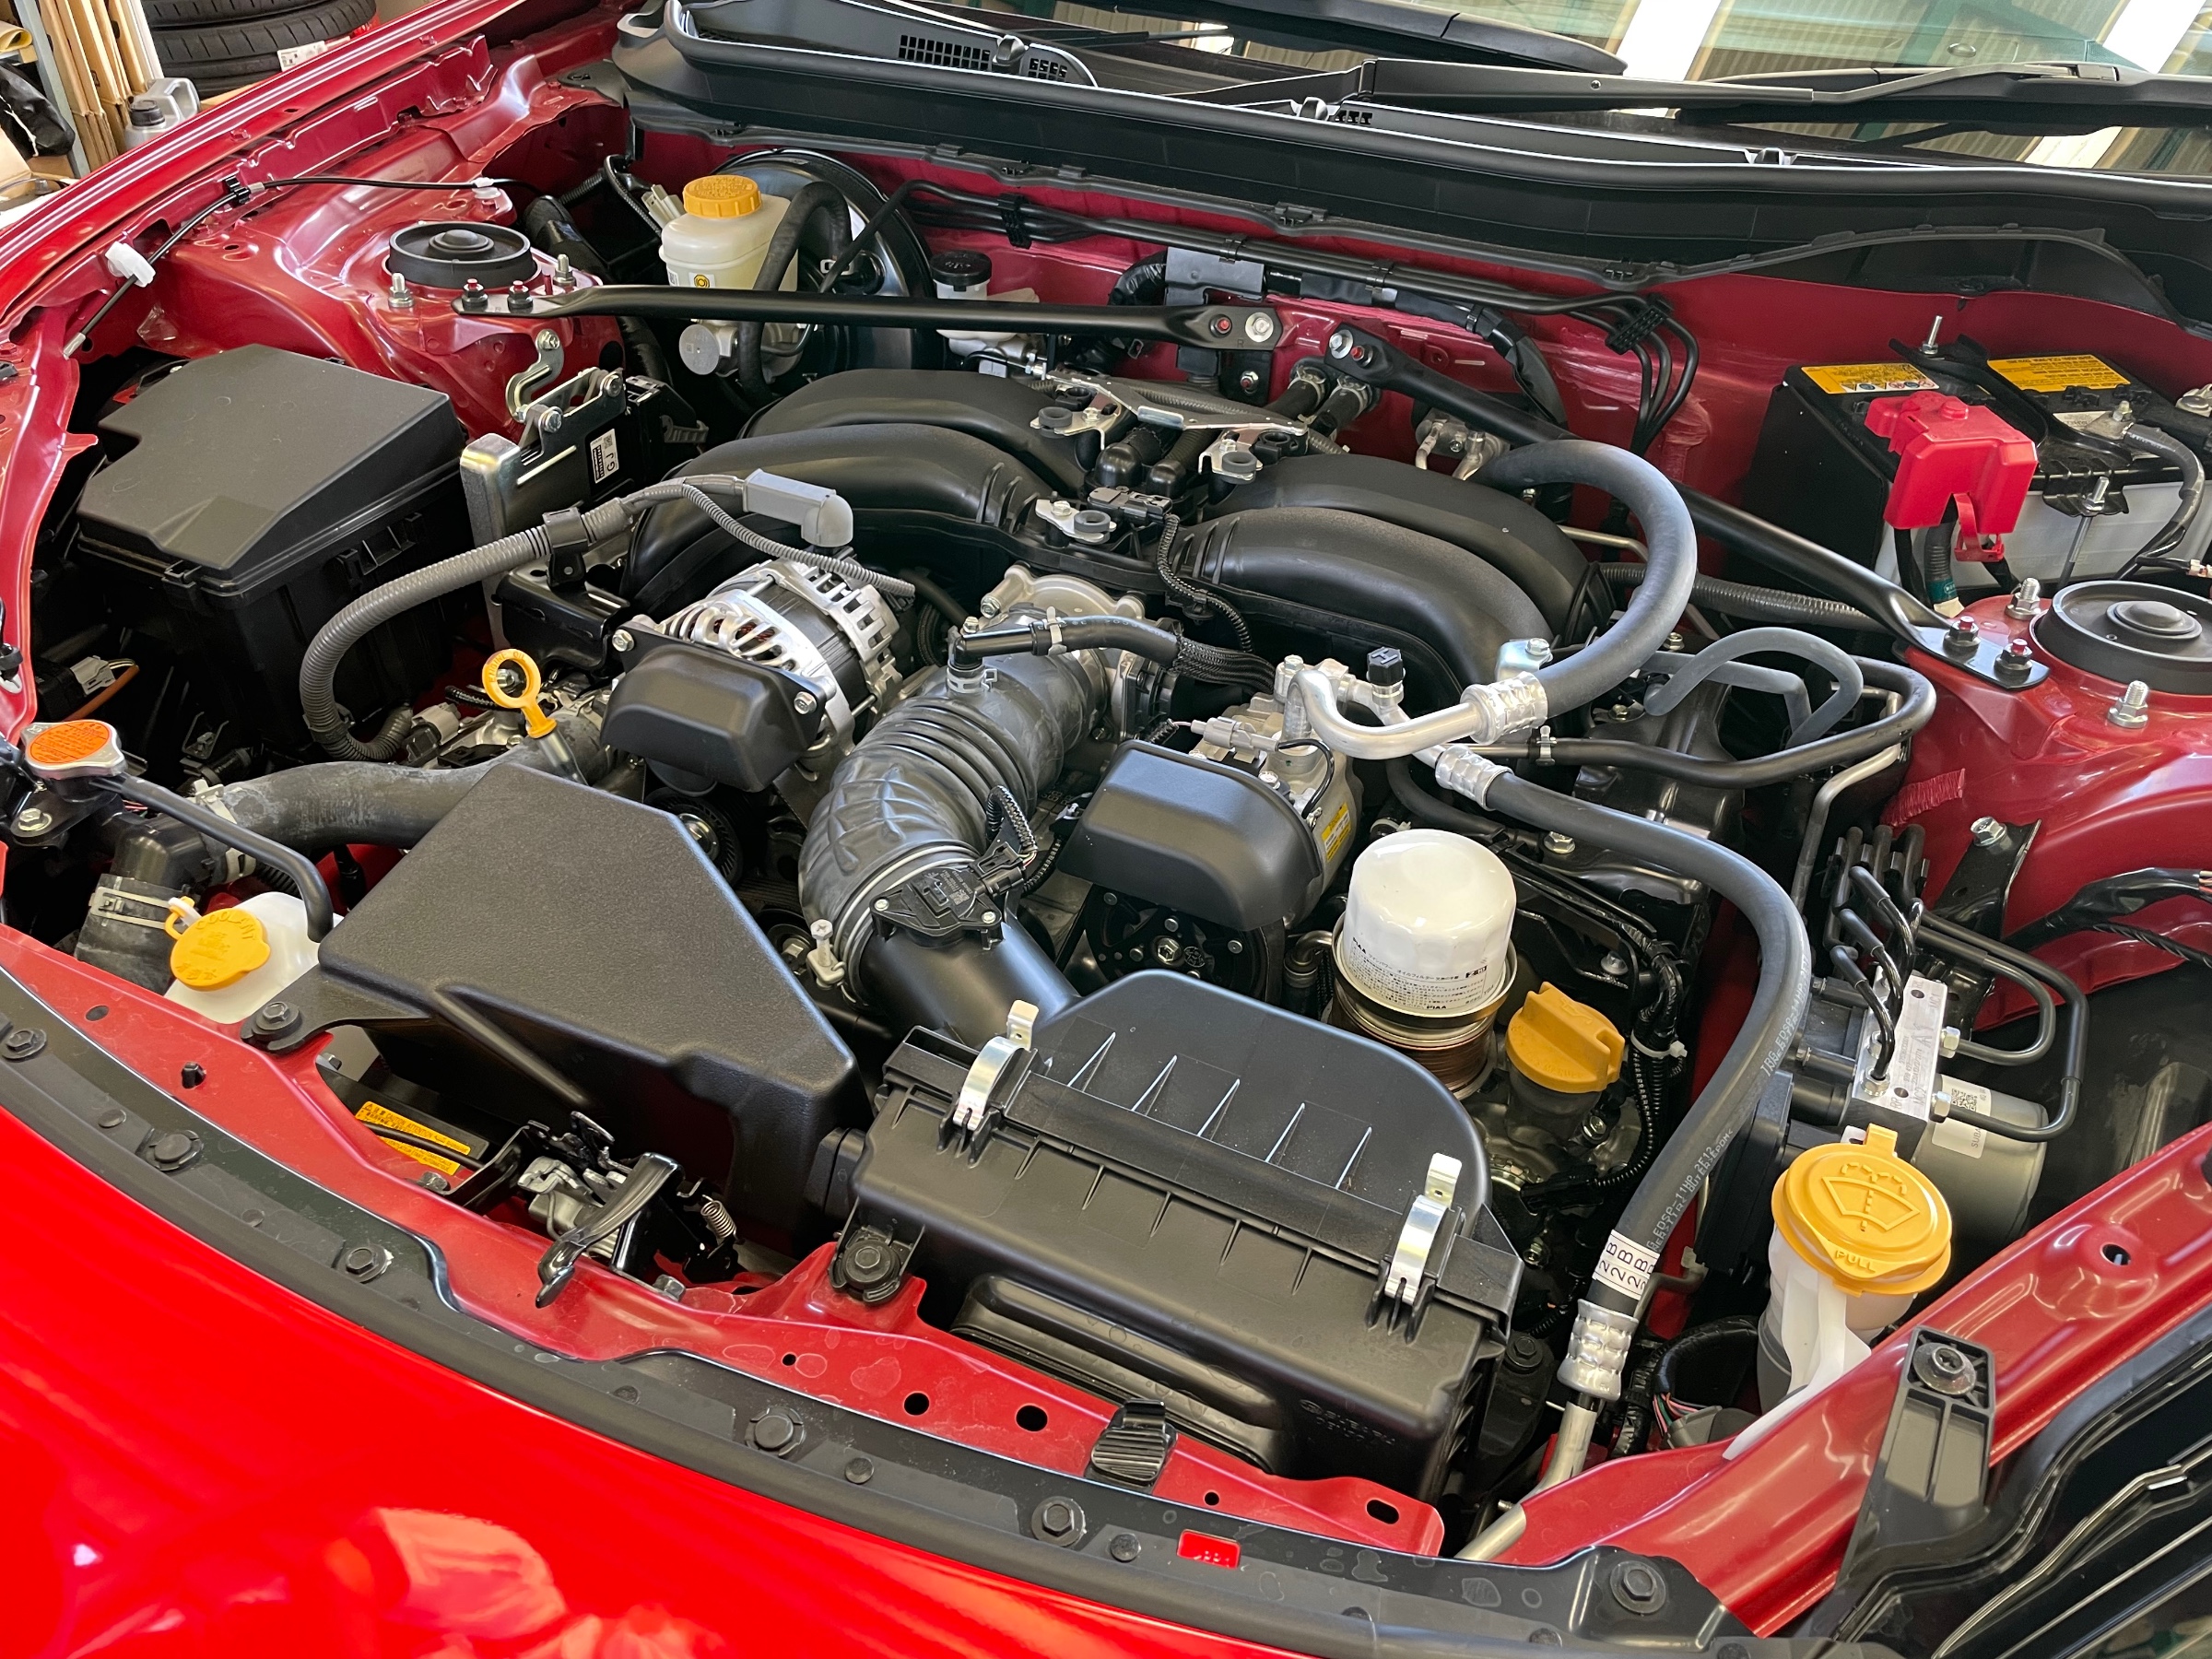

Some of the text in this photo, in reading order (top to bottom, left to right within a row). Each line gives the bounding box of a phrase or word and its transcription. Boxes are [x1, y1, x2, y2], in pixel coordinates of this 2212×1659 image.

[1237, 338, 1244, 348] R
[488, 651, 525, 683] ENGINE OIL
[1371, 647, 1398, 665] H
[194, 911, 255, 941] COOLANT
[1834, 1249, 1877, 1275] PULL
